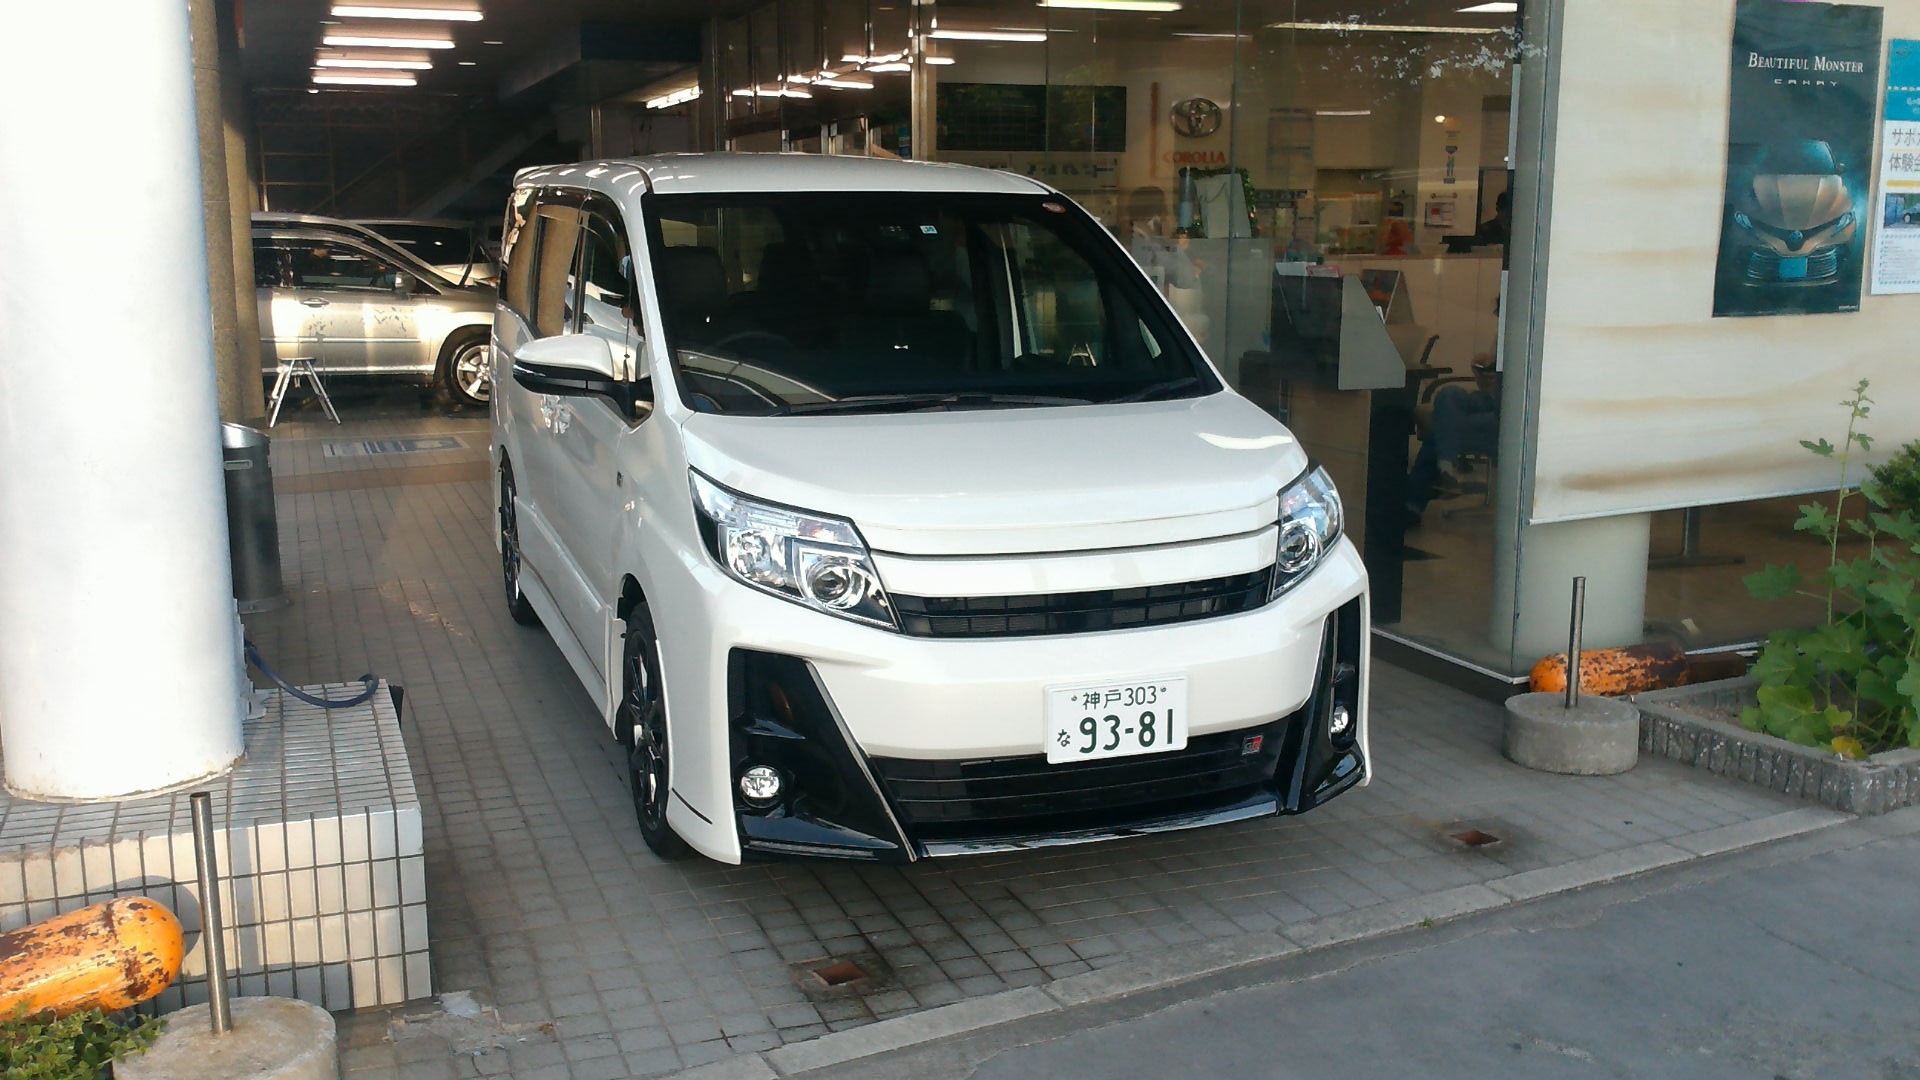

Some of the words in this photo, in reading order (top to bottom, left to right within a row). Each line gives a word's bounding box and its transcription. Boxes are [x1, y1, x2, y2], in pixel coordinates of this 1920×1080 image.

[1748, 52, 1808, 71] BEAUTIFUL
[1814, 55, 1863, 72] MONSTER
[1163, 151, 1226, 164] COROLLA
[1057, 728, 1071, 748] な
[1079, 708, 1174, 754] 93-81
